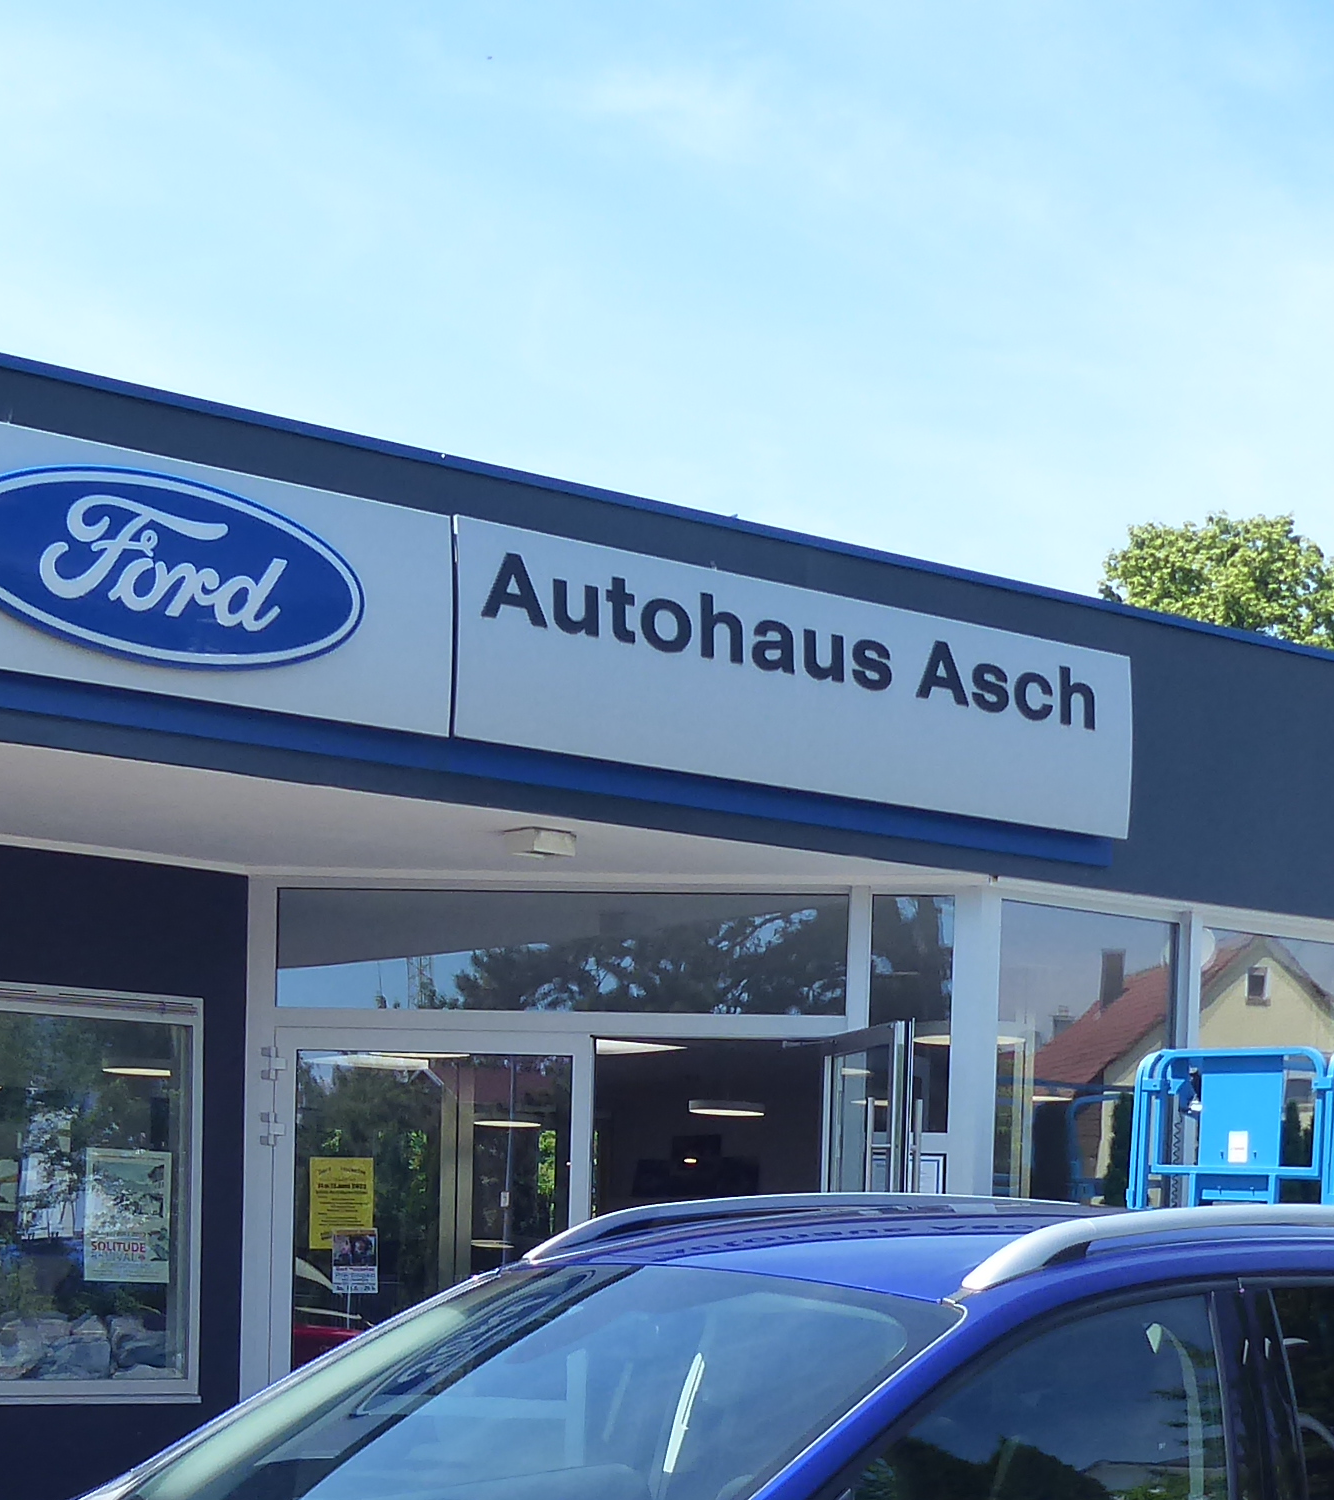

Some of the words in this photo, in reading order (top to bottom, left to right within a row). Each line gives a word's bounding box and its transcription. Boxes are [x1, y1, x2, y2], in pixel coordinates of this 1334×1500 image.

[38, 493, 288, 633] Ford
[480, 552, 893, 692] Autohaus
[915, 640, 1096, 731] Asch
[91, 1241, 146, 1253] SOLITUDE
